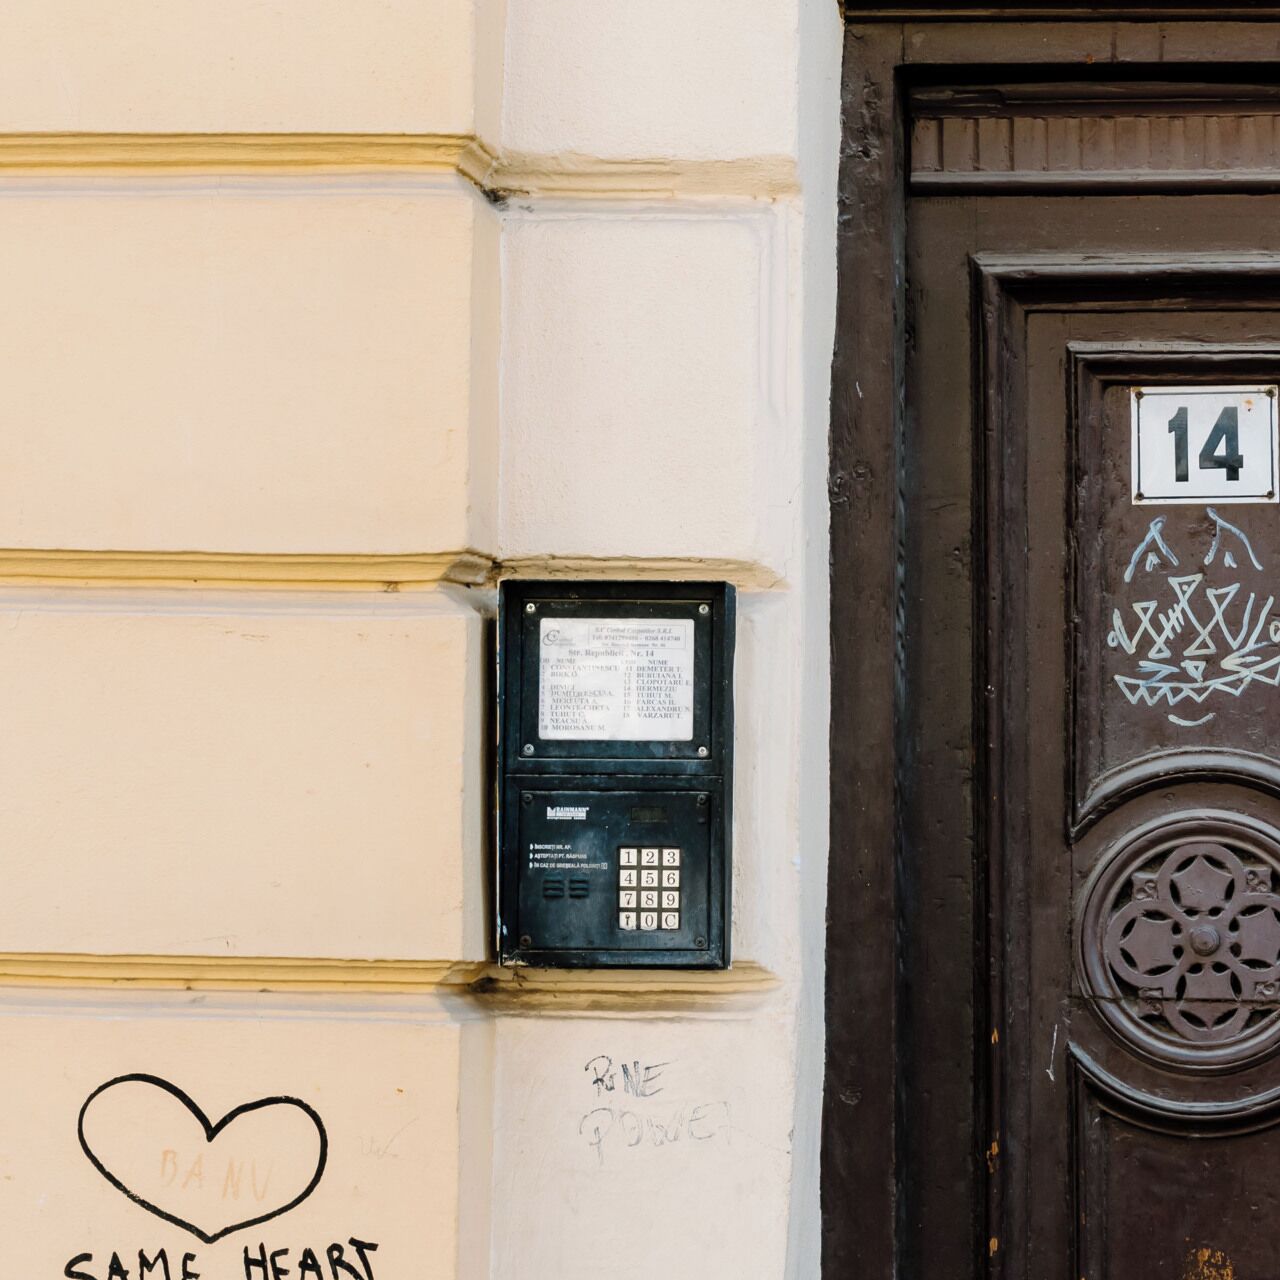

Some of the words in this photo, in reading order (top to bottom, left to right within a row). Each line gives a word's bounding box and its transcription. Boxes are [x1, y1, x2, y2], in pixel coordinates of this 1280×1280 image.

[1167, 406, 1244, 482] 14
[625, 851, 632, 864] 1
[646, 851, 655, 864] 2
[667, 851, 676, 864] 3
[624, 872, 633, 884] 4
[646, 872, 654, 885] 5
[667, 872, 676, 885] 6
[624, 893, 632, 905] 7
[645, 893, 654, 906] 8
[667, 893, 675, 906] 9
[645, 914, 654, 927] 0
[665, 914, 676, 927] C
